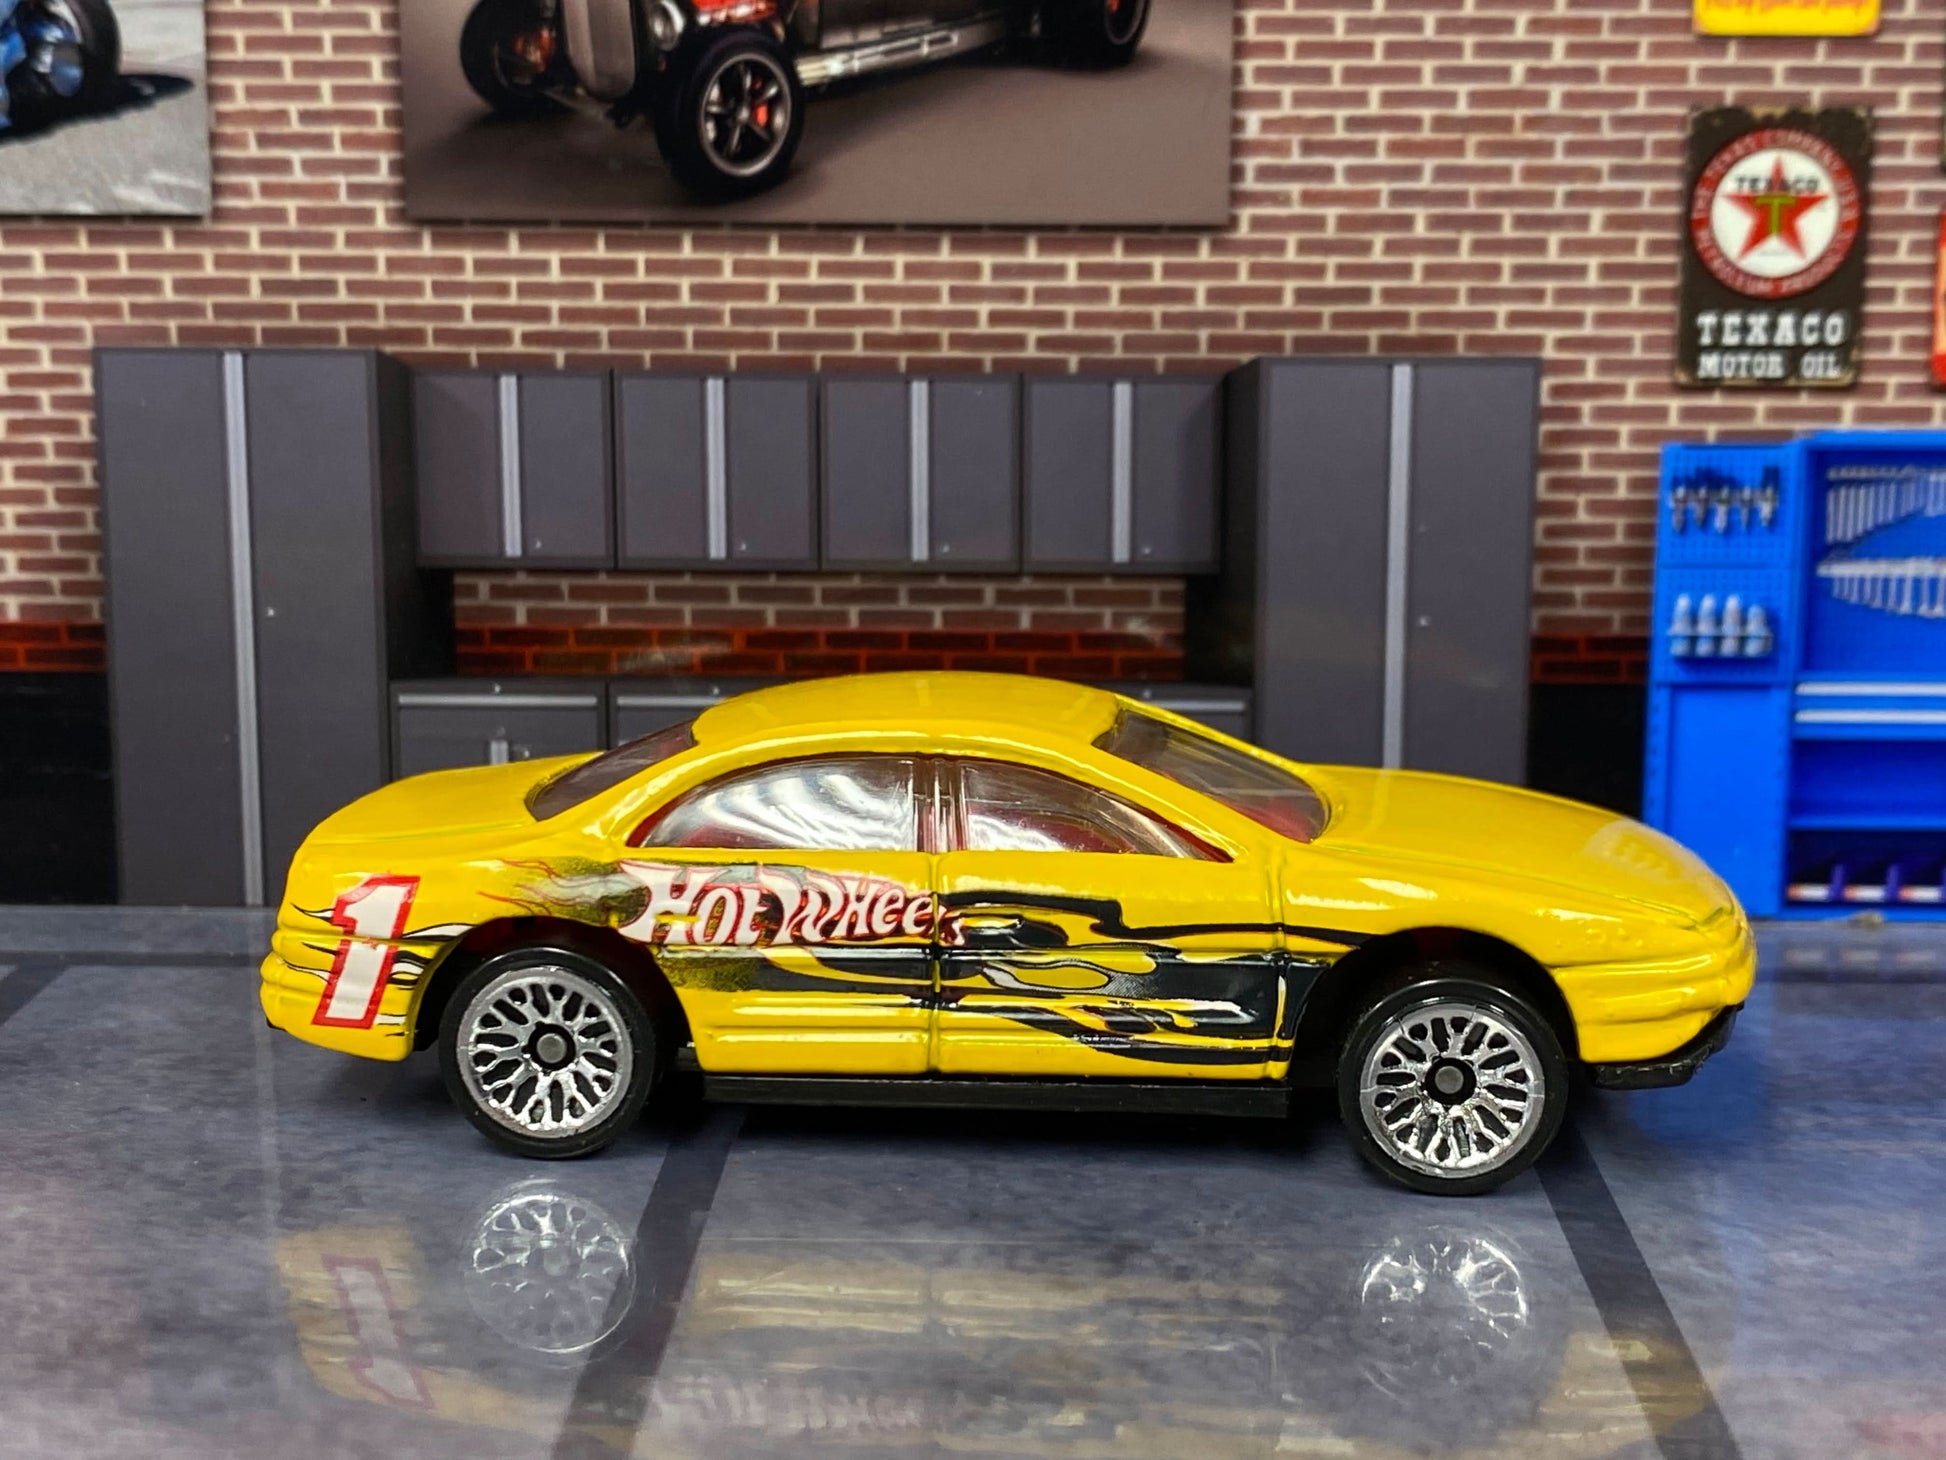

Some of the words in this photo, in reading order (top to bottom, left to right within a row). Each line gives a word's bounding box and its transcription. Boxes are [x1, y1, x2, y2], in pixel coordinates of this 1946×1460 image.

[1753, 192, 1797, 236] T
[1696, 312, 1846, 347] TEXACO
[1697, 352, 1785, 379] MOTOR
[1800, 352, 1842, 379] OIL
[310, 873, 421, 1030] 1
